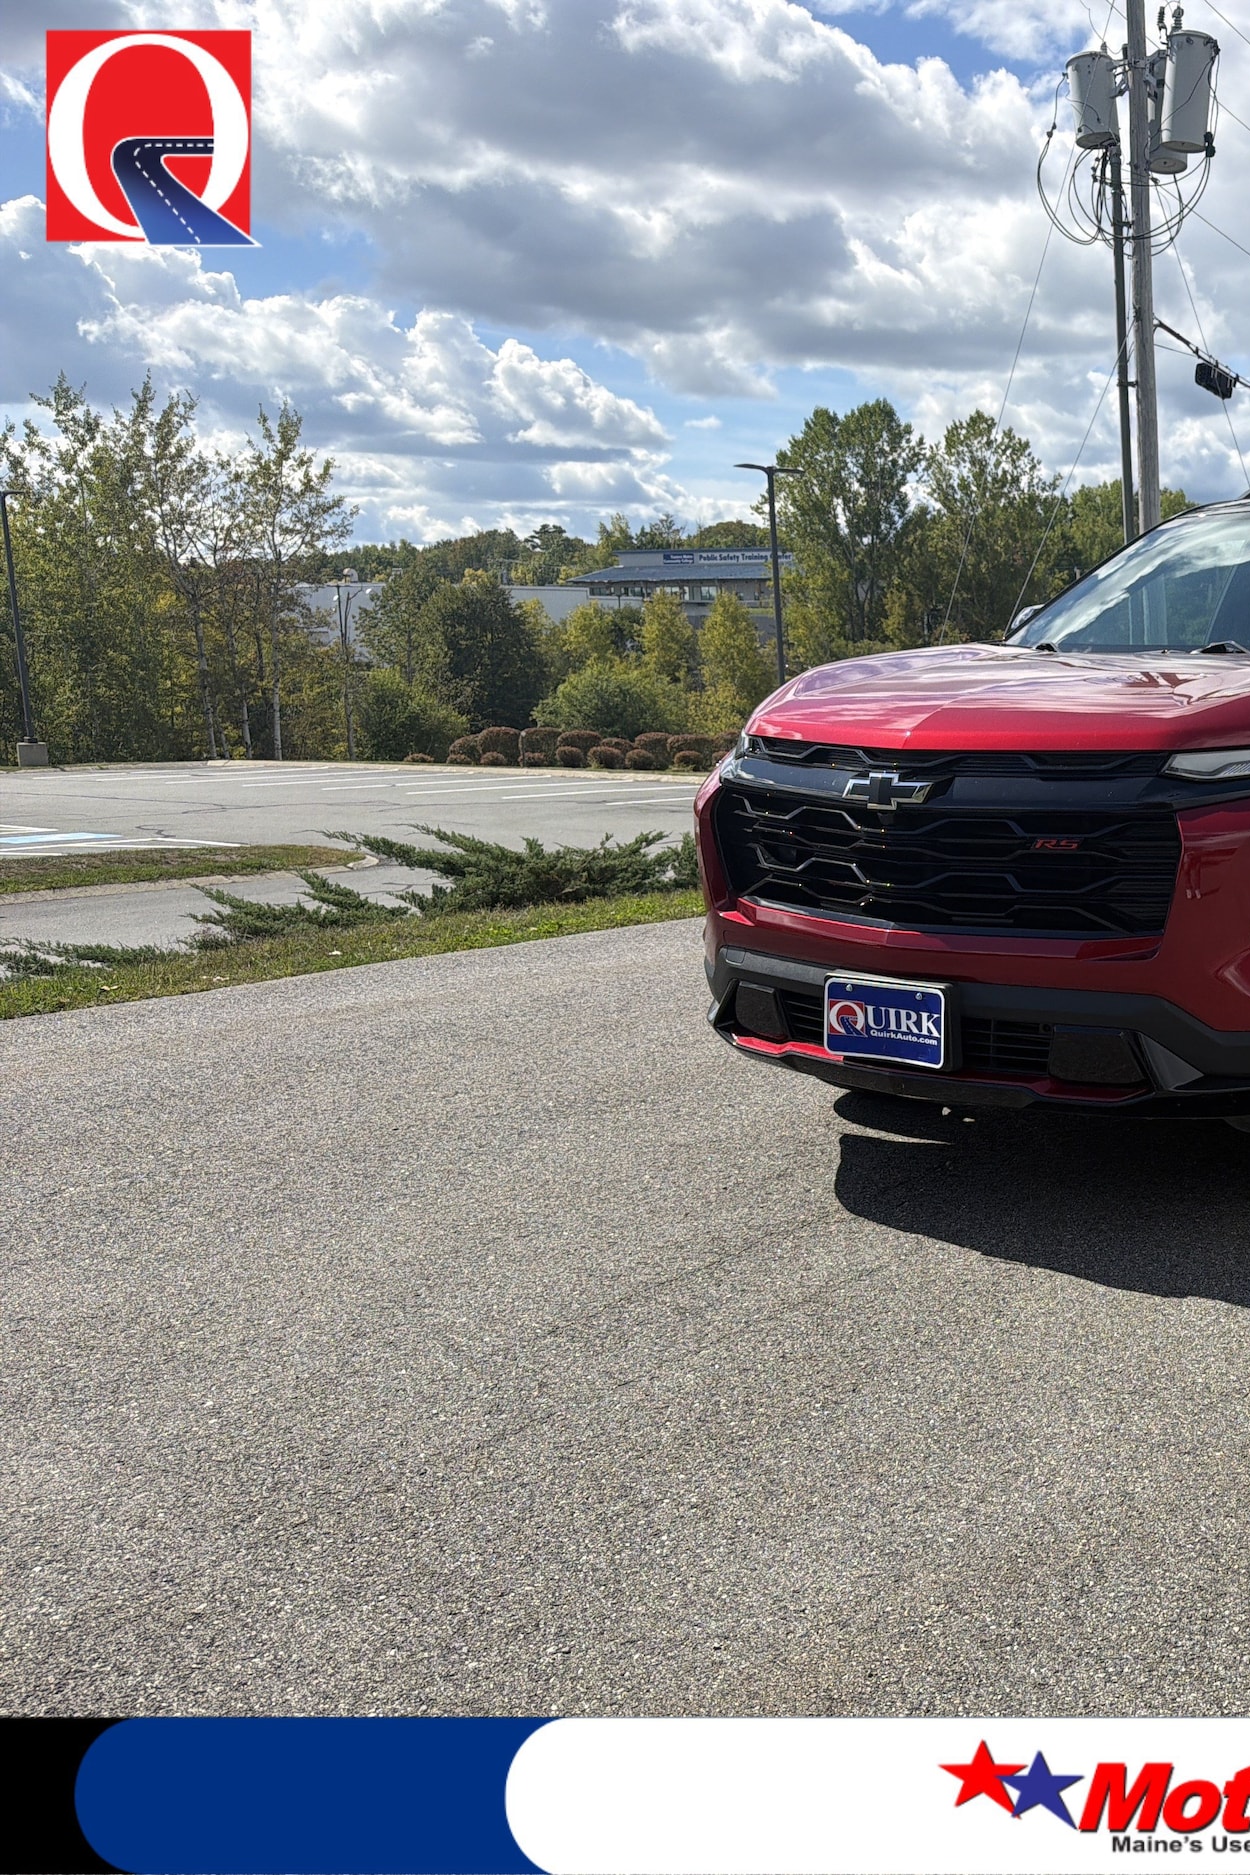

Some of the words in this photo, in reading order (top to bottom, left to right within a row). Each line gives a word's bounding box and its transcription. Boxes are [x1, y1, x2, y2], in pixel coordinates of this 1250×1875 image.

[699, 553, 717, 561] Public
[719, 553, 739, 562] Safety
[741, 553, 768, 562] Training
[1034, 838, 1079, 850] RS
[828, 1001, 941, 1037] QUIRK
[870, 1030, 938, 1046] QuirkAuto.com
